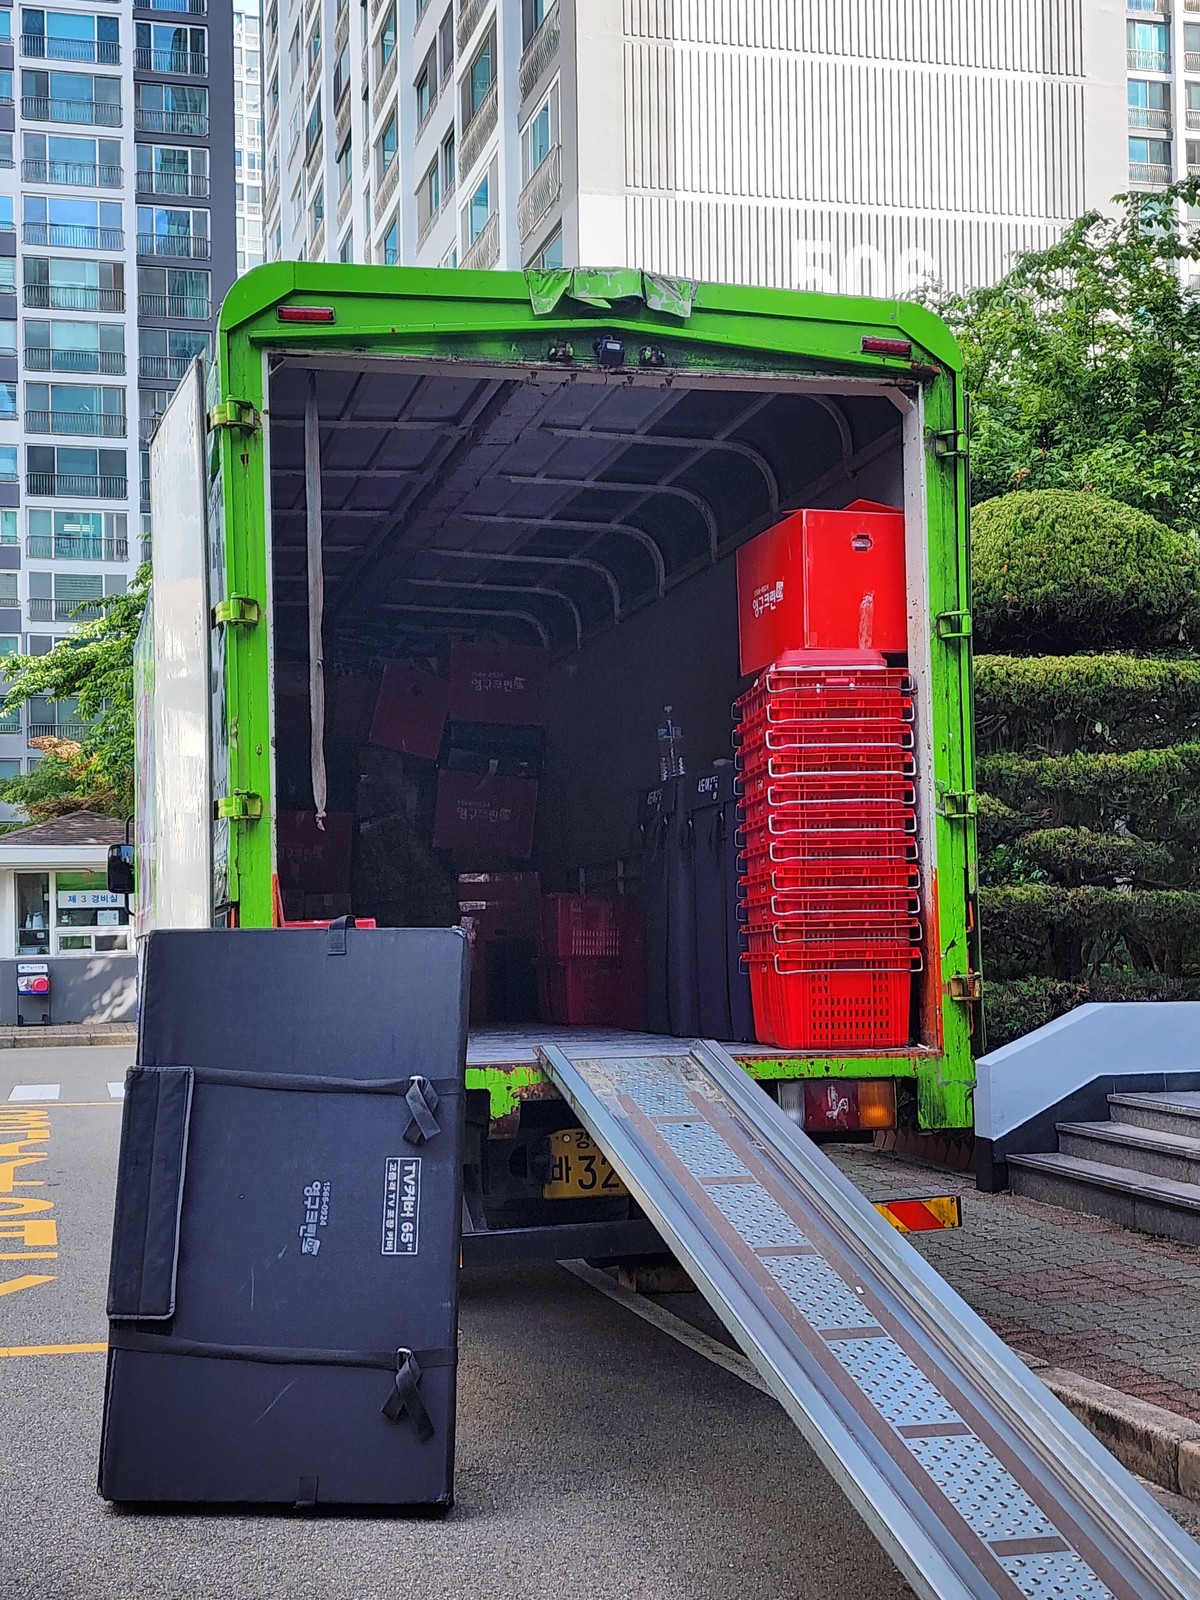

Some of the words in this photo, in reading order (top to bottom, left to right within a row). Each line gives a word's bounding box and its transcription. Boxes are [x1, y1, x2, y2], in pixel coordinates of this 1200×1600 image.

[752, 589, 776, 618] 영구크린
[67, 894, 77, 904] 제
[80, 894, 87, 903] 3
[91, 893, 118, 903] 경비실
[319, 1181, 332, 1226] 1566-0924
[387, 1193, 396, 1207] TV
[400, 1162, 416, 1218] TV커버
[299, 1181, 321, 1238] 영구크린
[386, 1208, 395, 1230] 포장
[385, 1231, 394, 1251] 커버
[400, 1221, 414, 1251] 65"
